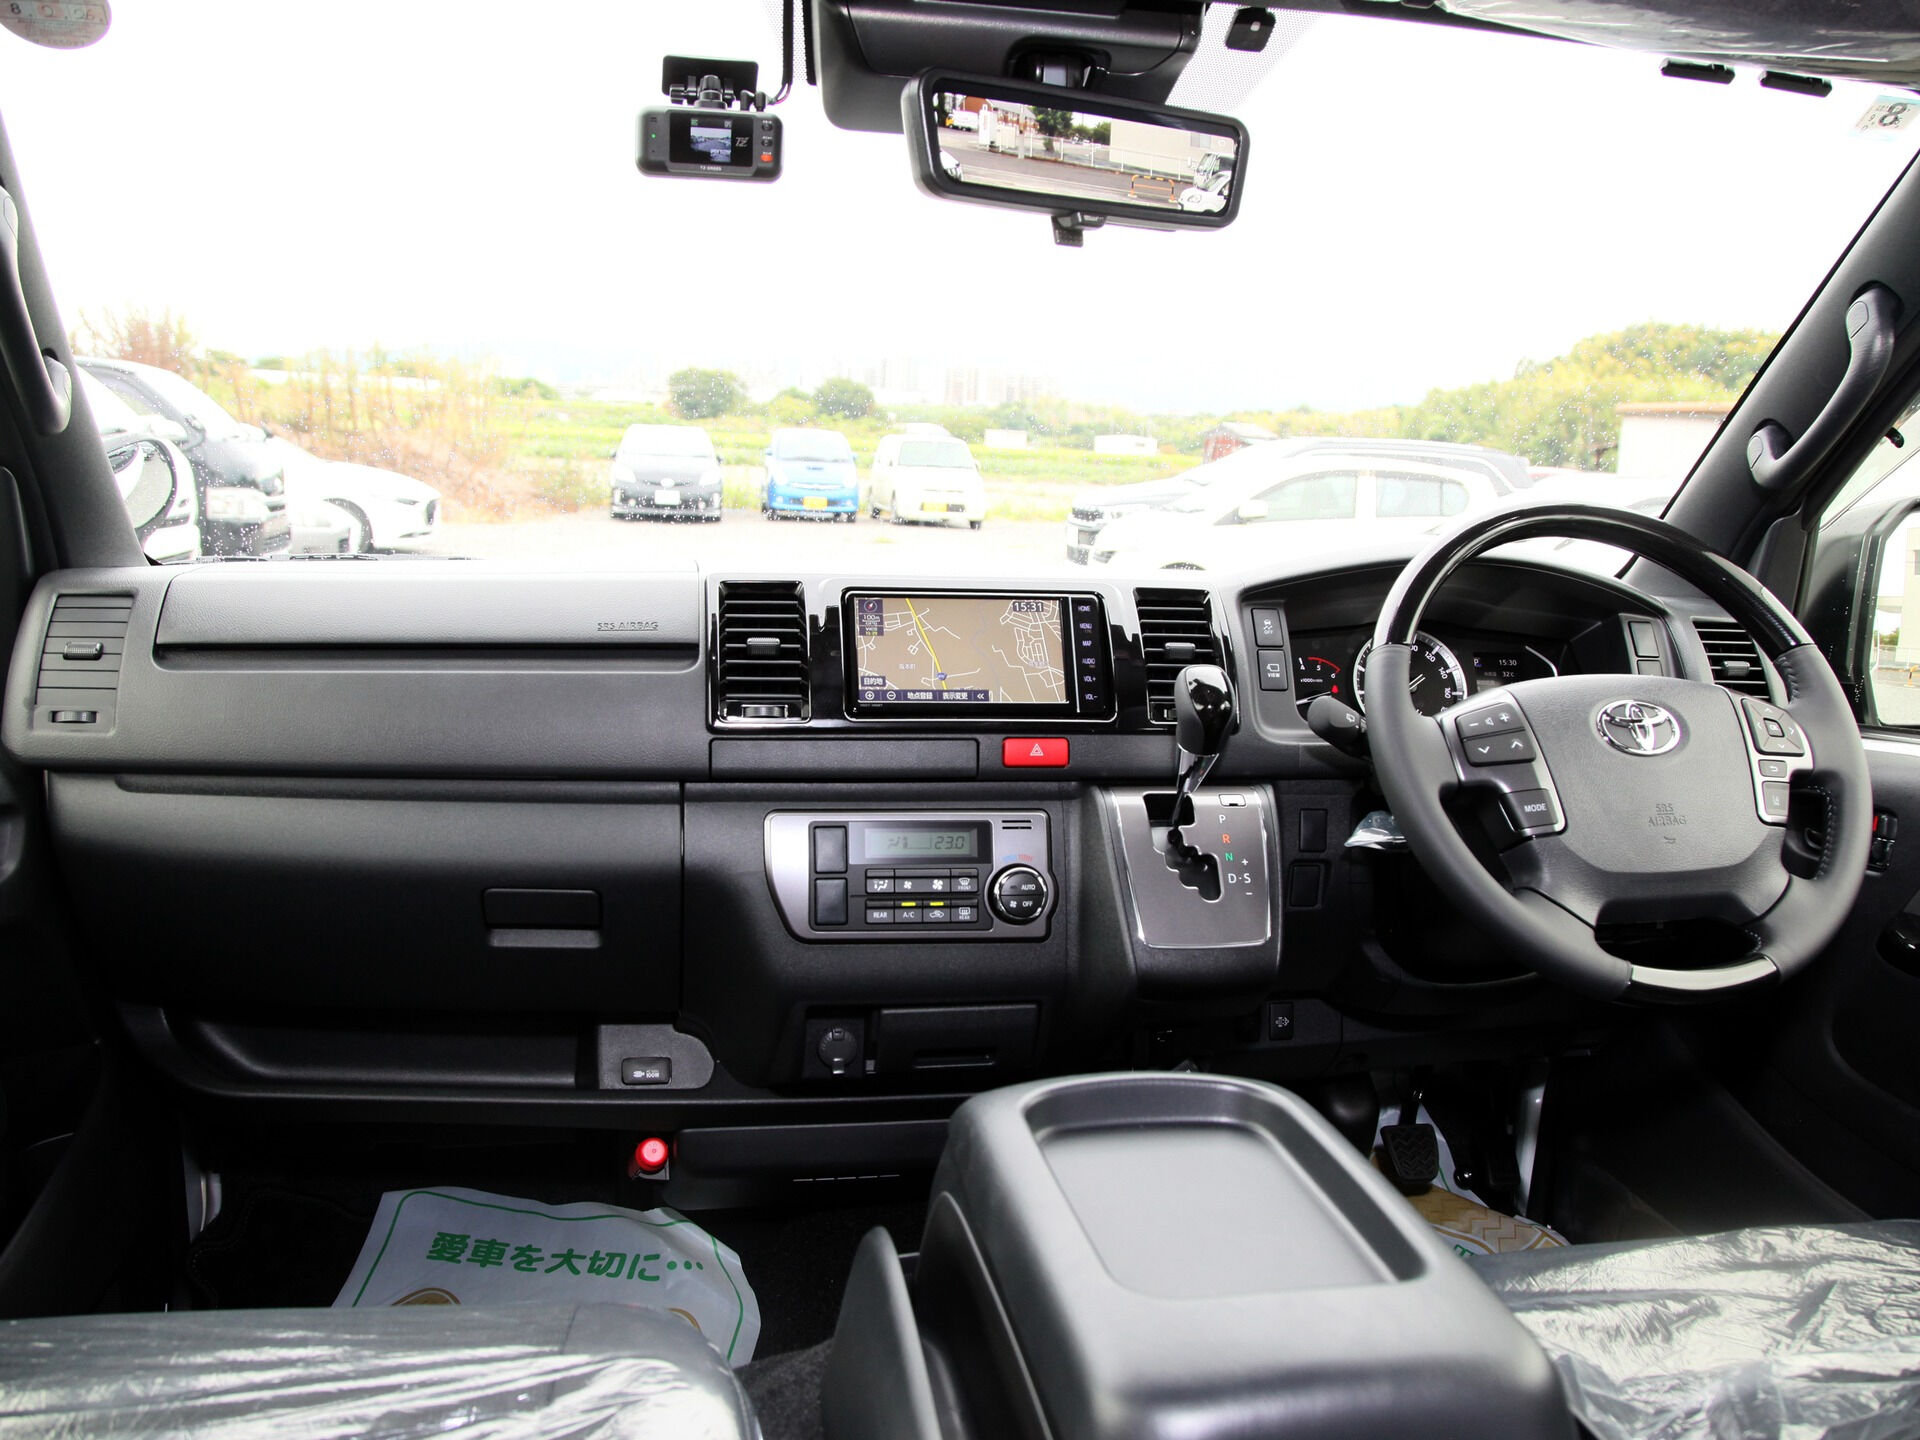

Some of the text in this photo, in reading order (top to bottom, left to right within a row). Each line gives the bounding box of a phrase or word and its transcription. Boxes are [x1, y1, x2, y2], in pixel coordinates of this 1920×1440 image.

[1013, 602, 1043, 611] 15:31
[597, 621, 659, 631] SRS AIRBAG
[1424, 651, 1436, 663] 120
[1438, 667, 1448, 680] 140
[1524, 802, 1547, 813] MODE
[1219, 815, 1226, 823] P
[1648, 815, 1687, 826] AIRBAG
[1222, 834, 1231, 843] R
[1225, 853, 1233, 861] N
